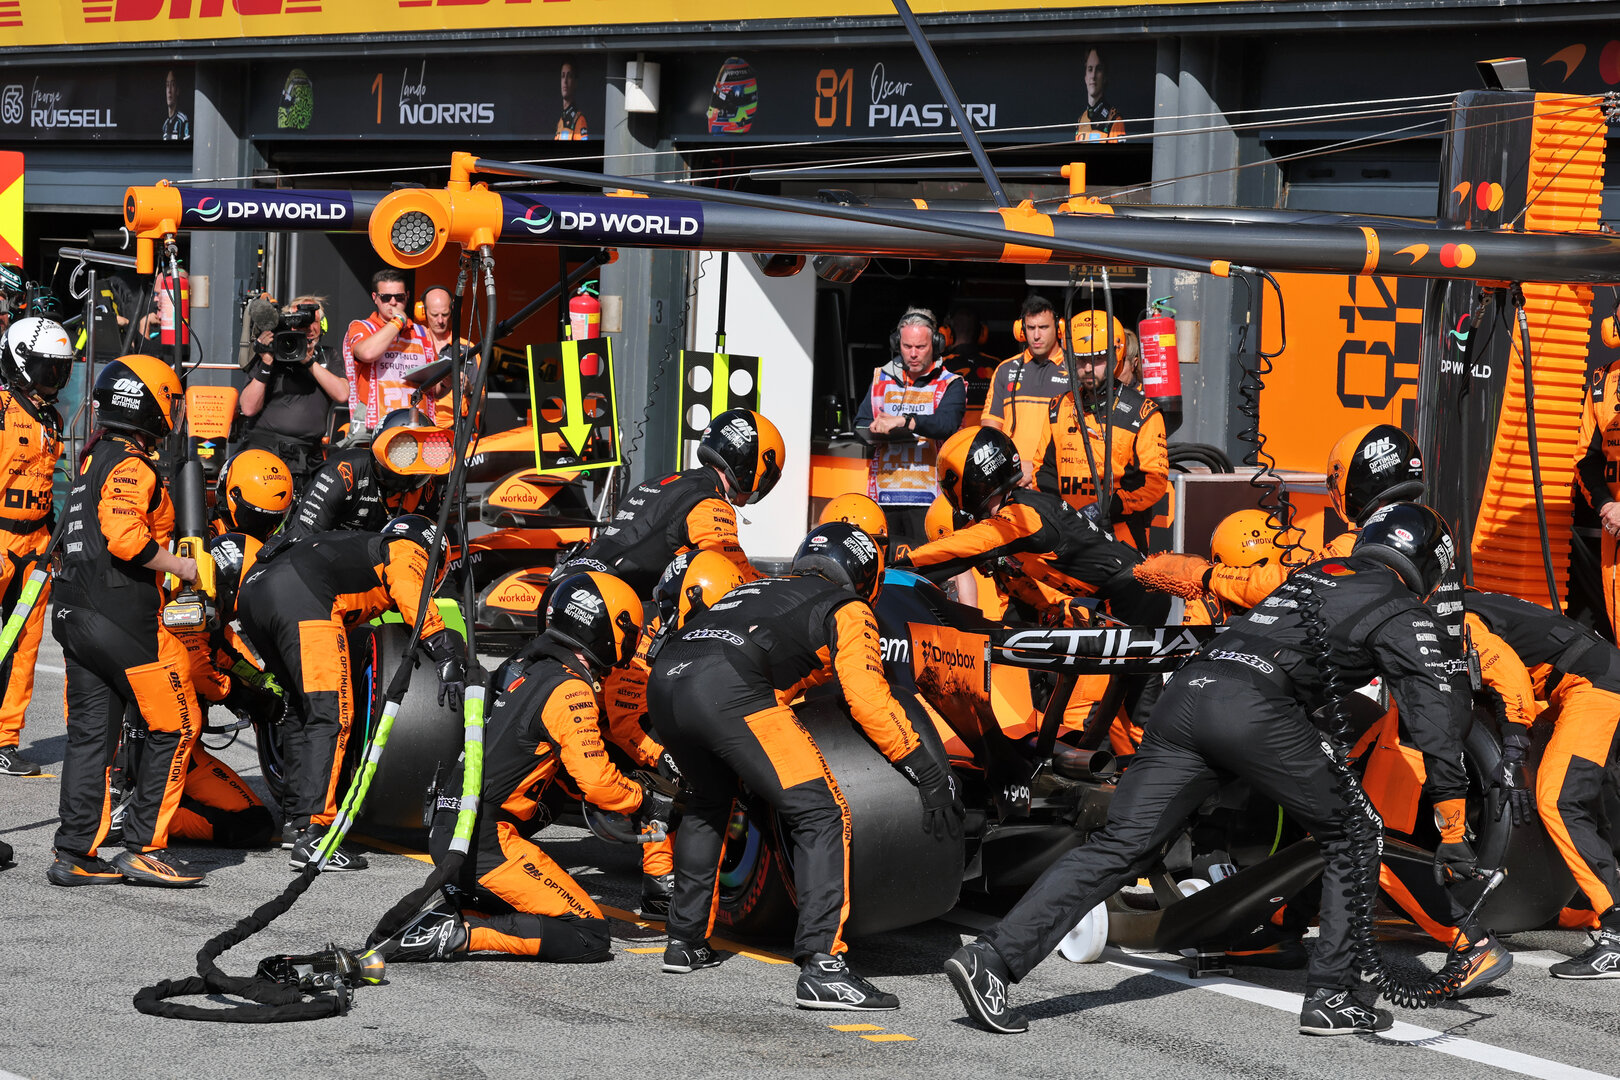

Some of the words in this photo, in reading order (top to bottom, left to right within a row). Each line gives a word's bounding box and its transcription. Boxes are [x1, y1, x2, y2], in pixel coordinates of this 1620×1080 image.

[399, 60, 427, 105] Lando
[870, 62, 913, 105] Oscar
[1, 84, 24, 125] 63
[371, 73, 383, 124] 1
[814, 68, 854, 127] 81
[31, 109, 117, 128] RUSSELL
[400, 103, 495, 124] NORRIS
[227, 201, 259, 219] DP
[261, 202, 346, 220] WORLD
[560, 211, 596, 231] DP
[600, 213, 699, 236] WORLD
[655, 300, 663, 324] 3
[1441, 360, 1451, 373] DP
[1453, 361, 1491, 379] WRLD
[112, 378, 145, 396] ON
[111, 400, 140, 410] NUTRITION
[112, 394, 141, 404] OPTIMUM
[974, 441, 998, 466] ON
[1364, 437, 1393, 460] ON
[1369, 452, 1400, 470] OPTIMUM
[1371, 459, 1402, 475] NUTRITION
[500, 494, 538, 505] workday
[852, 531, 877, 556] ON
[498, 594, 536, 604] workday
[571, 589, 603, 612] ON
[564, 608, 592, 626] NUTRITION
[566, 602, 594, 622] OPTIMUM
[932, 646, 975, 670] Dropbox
[1002, 628, 1231, 665] ETIHA
[340, 656, 348, 699] OPTIMUM
[177, 693, 192, 735] OPTIMUM
[807, 736, 834, 784] OPTIMUM
[832, 785, 851, 841] NUTRITION
[522, 861, 544, 881] ON
[544, 878, 586, 914] OPTIMUM
